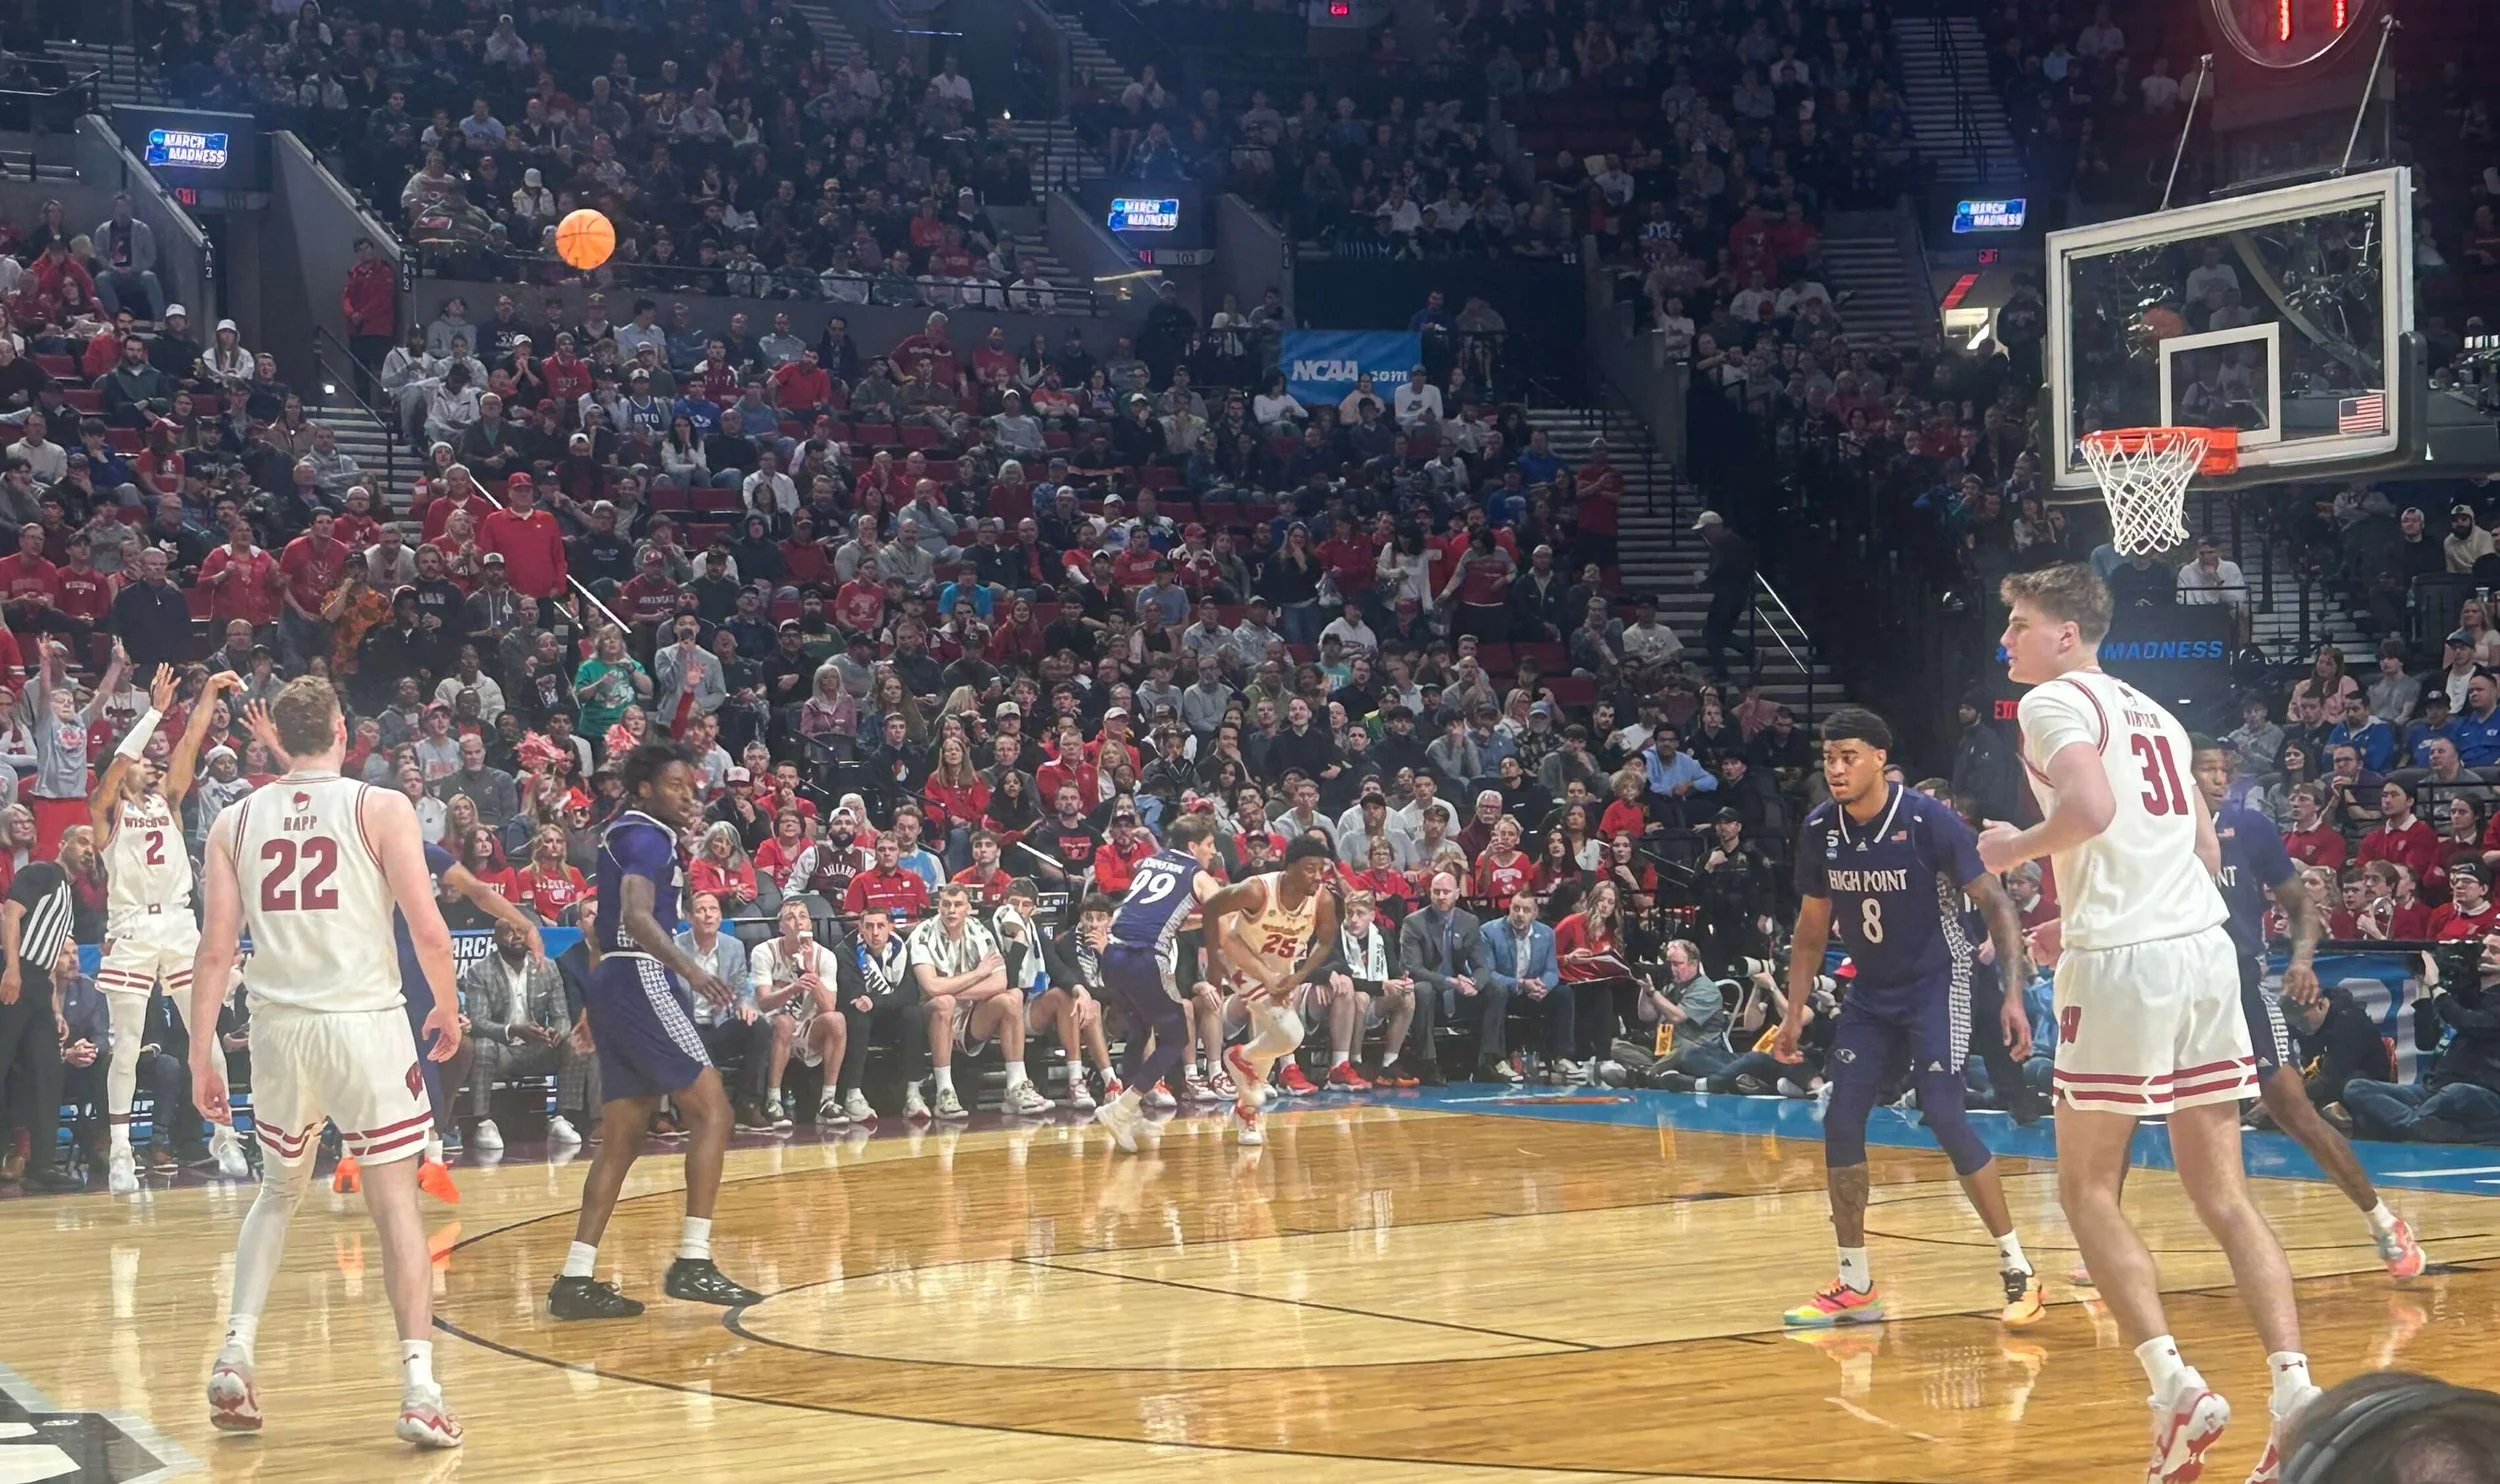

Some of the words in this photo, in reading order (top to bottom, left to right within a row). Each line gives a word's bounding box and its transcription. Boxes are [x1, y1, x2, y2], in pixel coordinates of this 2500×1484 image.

[164, 134, 205, 147] MARCH
[169, 148, 224, 162] MADNESS
[2103, 640, 2224, 661] MADNESS
[2131, 733, 2188, 816] 31
[284, 815, 318, 832] RAPP
[145, 830, 165, 866] 2
[261, 836, 339, 912] 22
[1123, 868, 1176, 904] 99
[1828, 869, 1861, 892] HIGH
[1863, 868, 1907, 892] POINT
[1861, 898, 1884, 944] 8
[1261, 933, 1298, 958] 25
